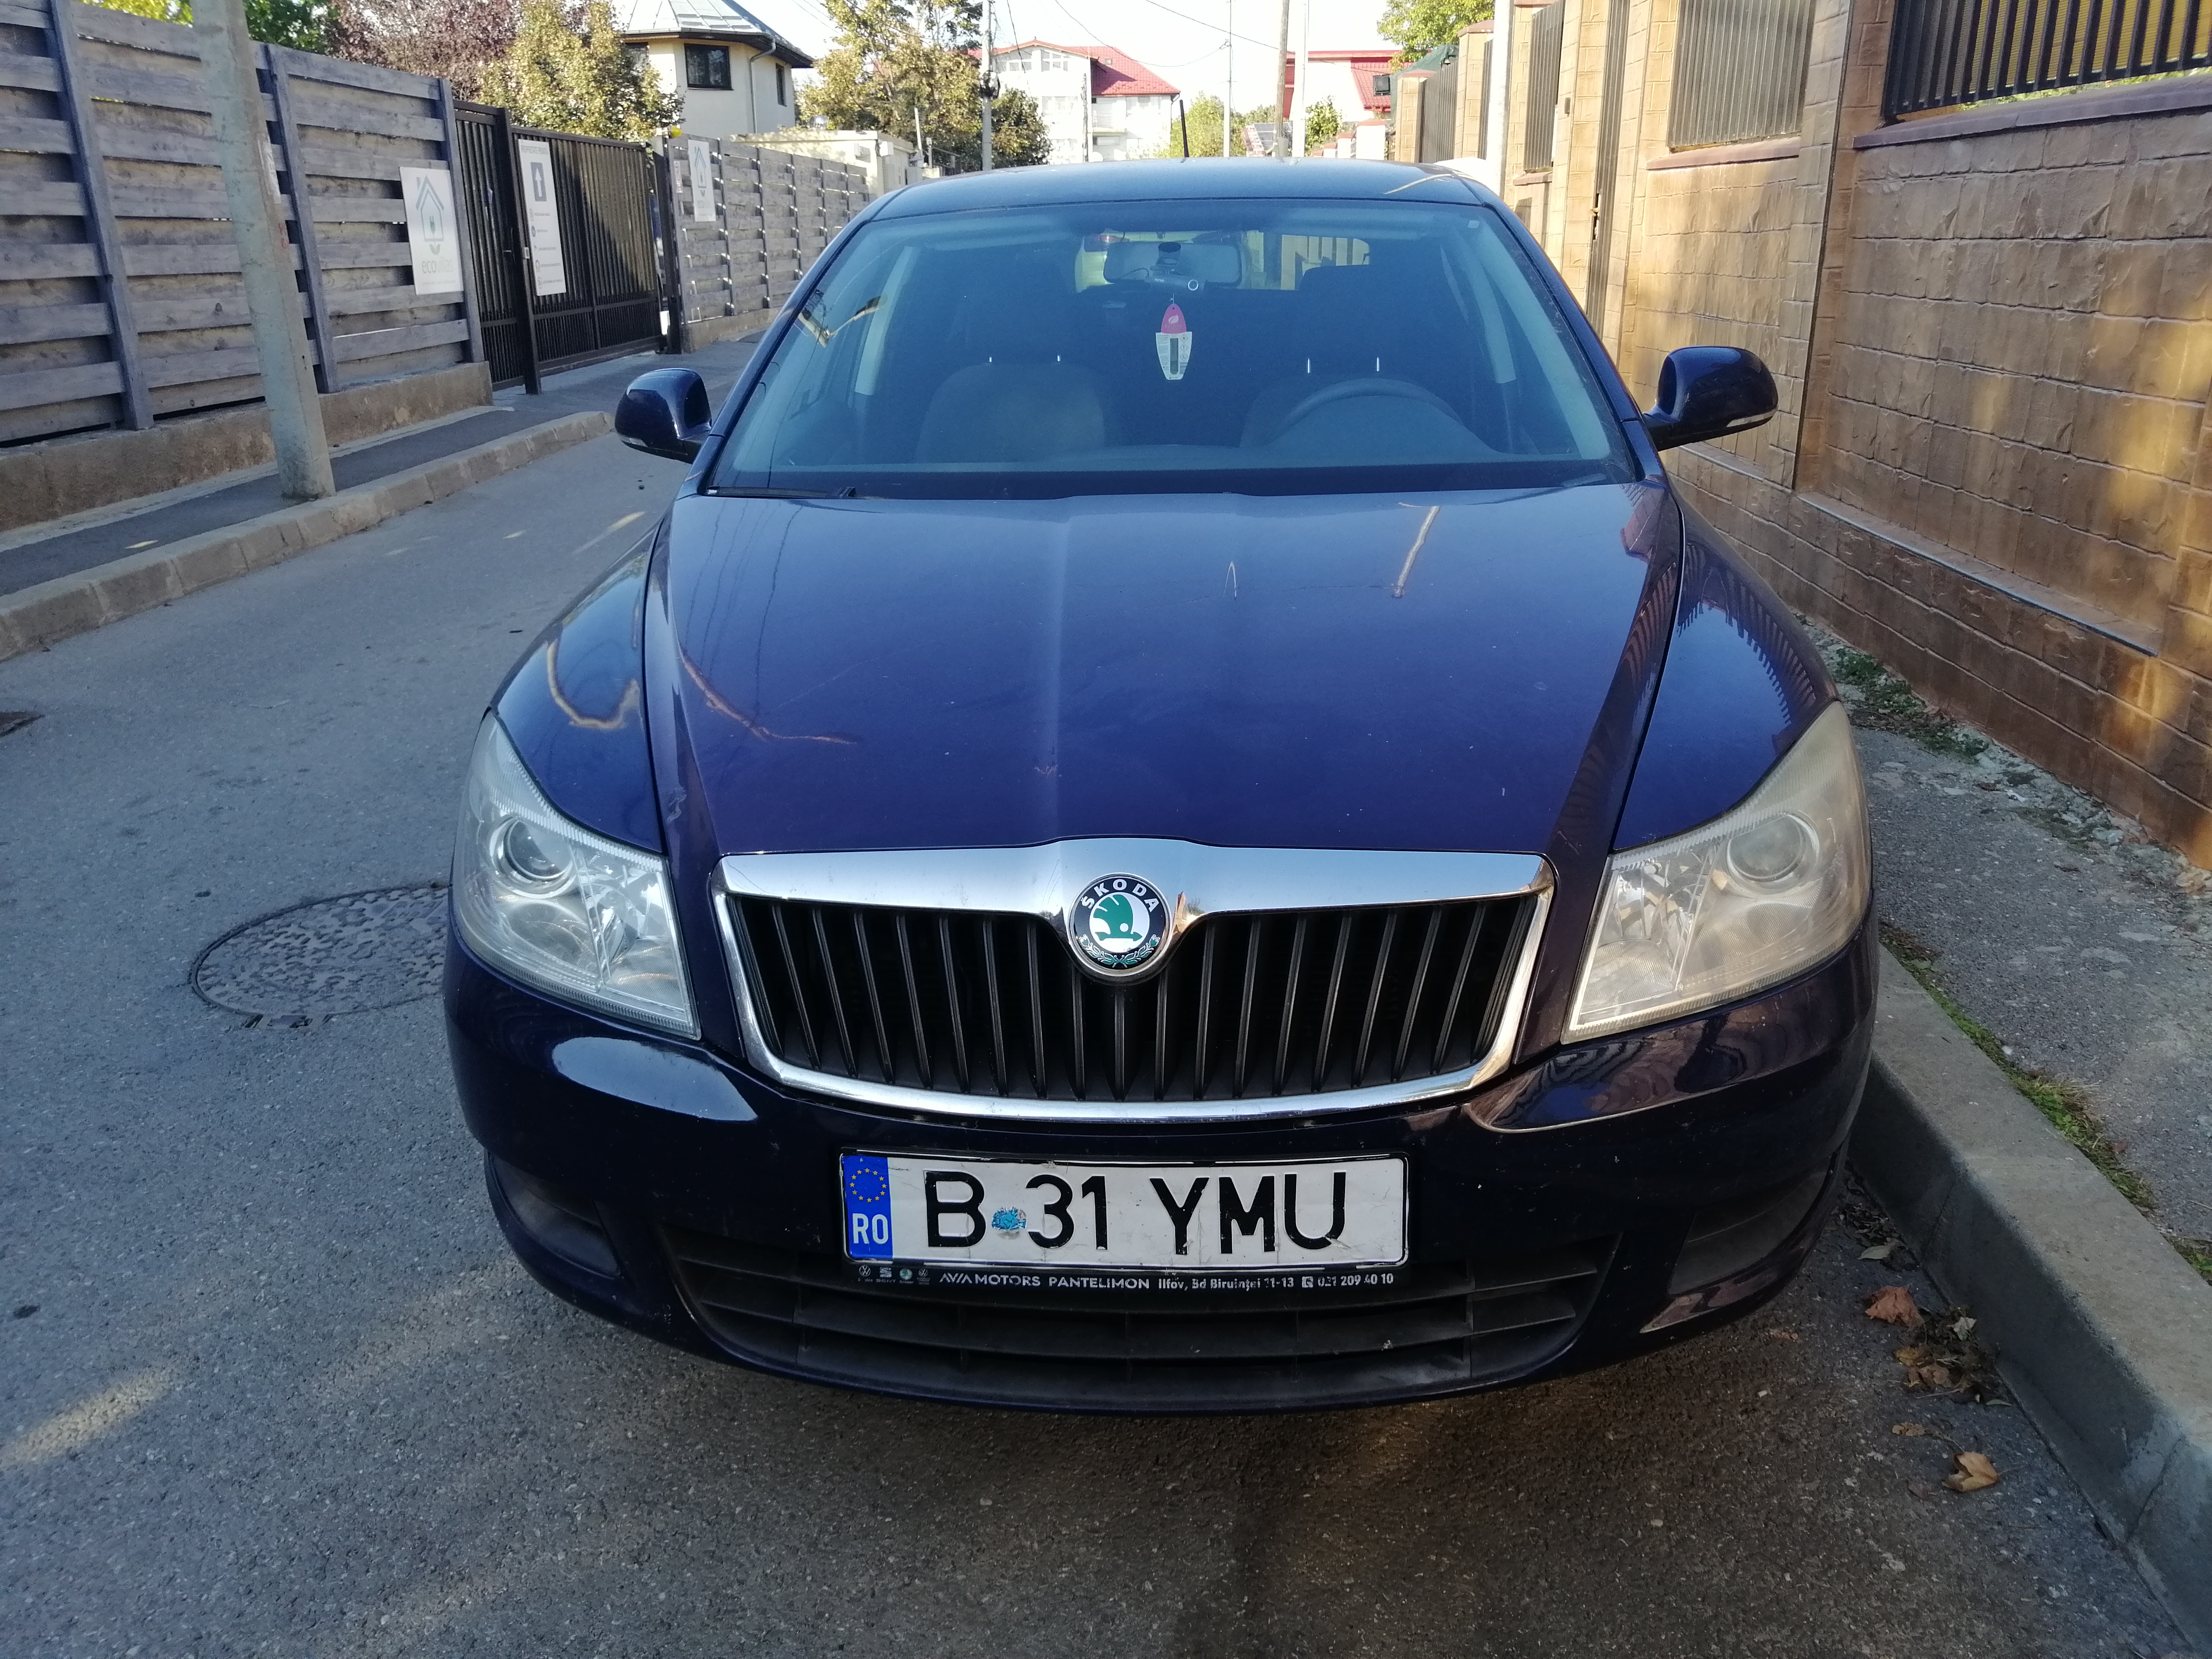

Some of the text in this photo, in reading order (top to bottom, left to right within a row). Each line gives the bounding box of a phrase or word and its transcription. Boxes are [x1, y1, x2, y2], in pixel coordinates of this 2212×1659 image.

[923, 1170, 1346, 1255] B 31 YMU
[852, 1213, 888, 1244] RO
[975, 1274, 1041, 1286] MOTORS
[1049, 1276, 1150, 1289] PANTELIMON
[1340, 1274, 1361, 1286] 209
[1381, 1273, 1394, 1284] 10
